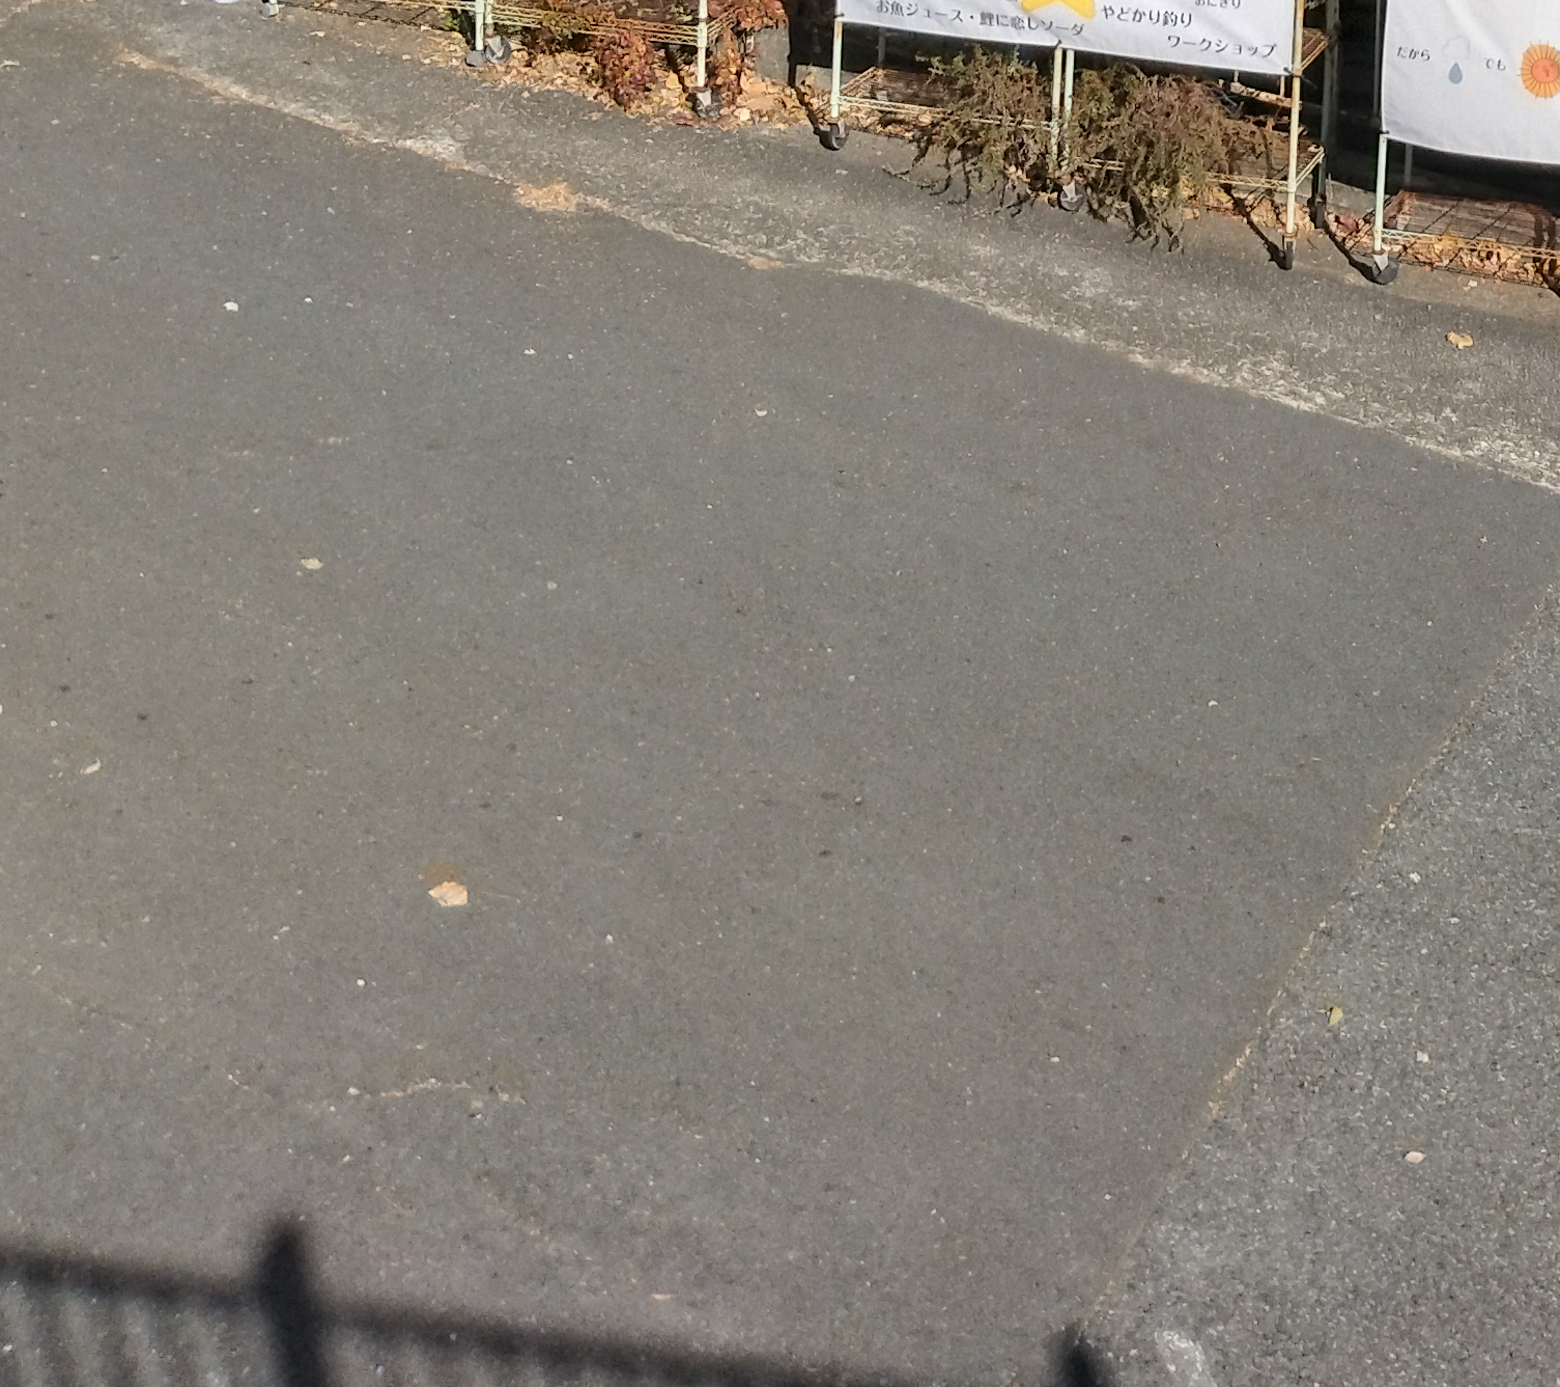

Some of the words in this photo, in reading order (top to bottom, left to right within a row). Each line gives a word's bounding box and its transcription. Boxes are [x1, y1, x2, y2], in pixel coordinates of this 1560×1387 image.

[1101, 4, 1193, 28] やどかり釣り
[1167, 34, 1277, 59] ワークショップ
